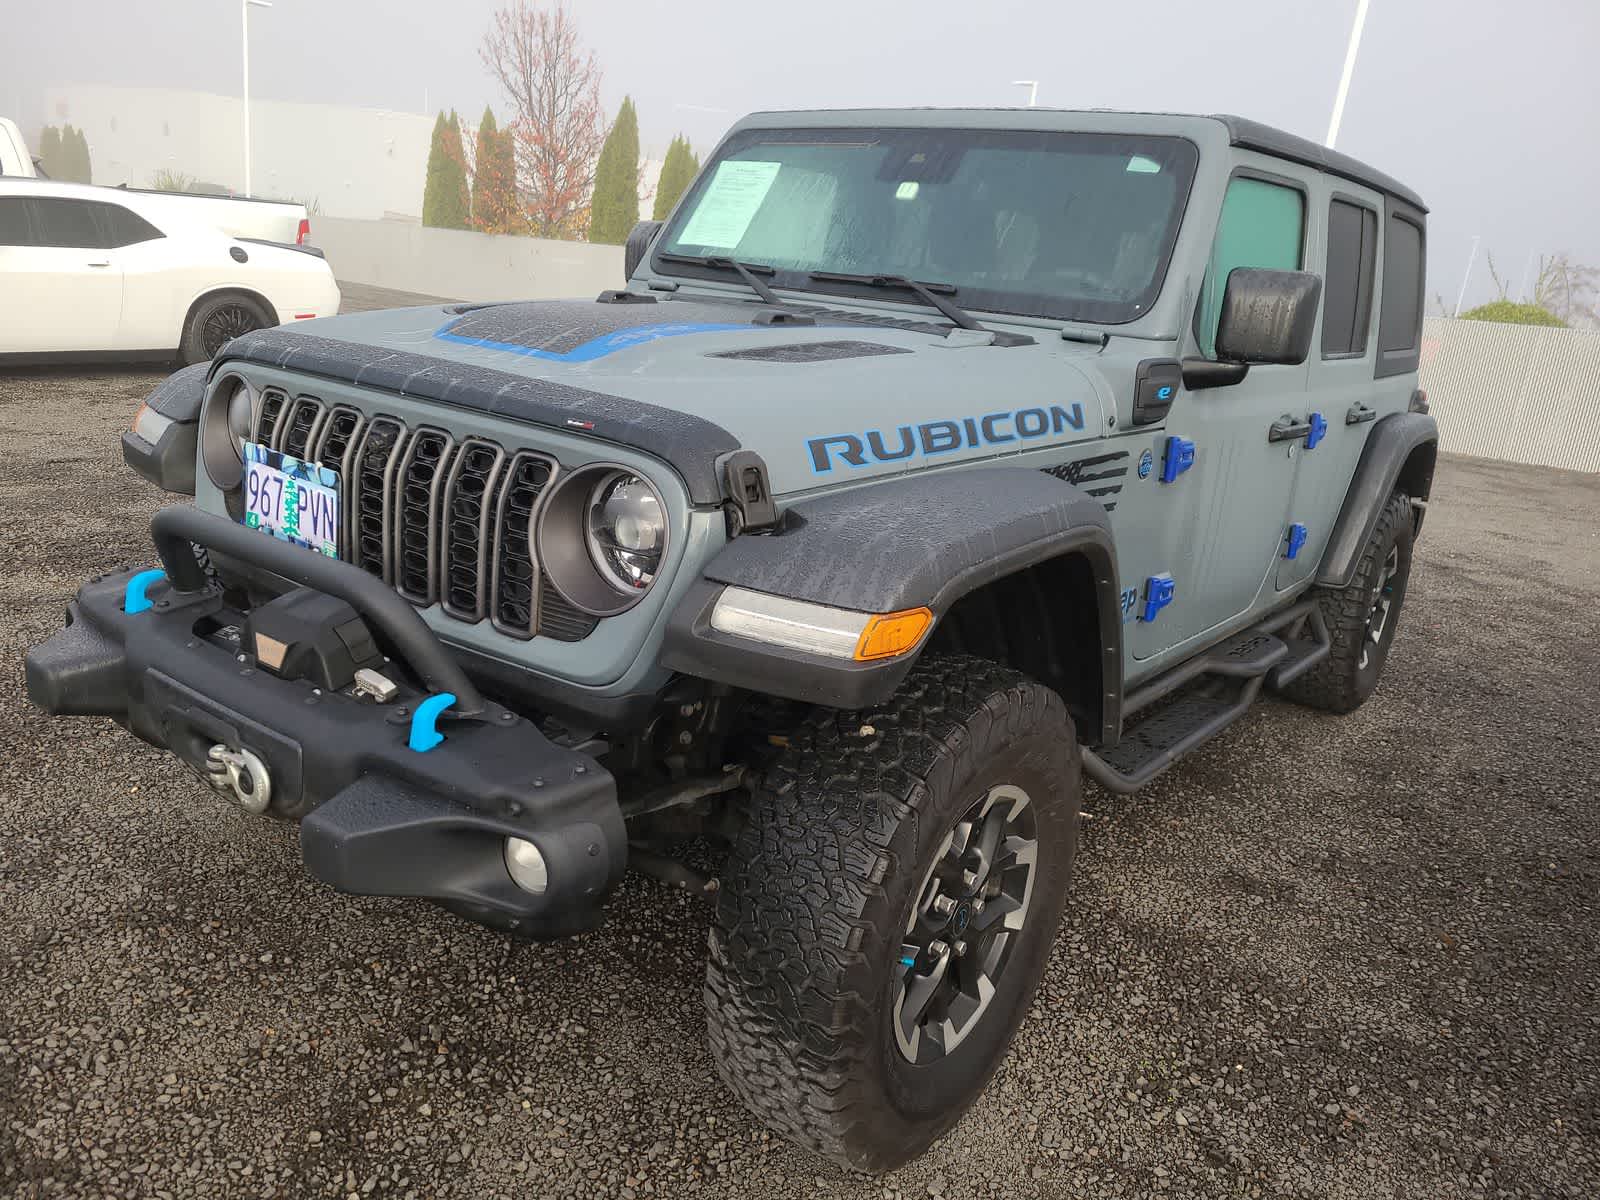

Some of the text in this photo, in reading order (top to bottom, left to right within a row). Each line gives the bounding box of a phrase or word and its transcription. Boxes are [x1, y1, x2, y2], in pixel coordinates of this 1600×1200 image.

[805, 403, 1084, 473] RUBICON
[249, 469, 334, 542] 967 PVN
